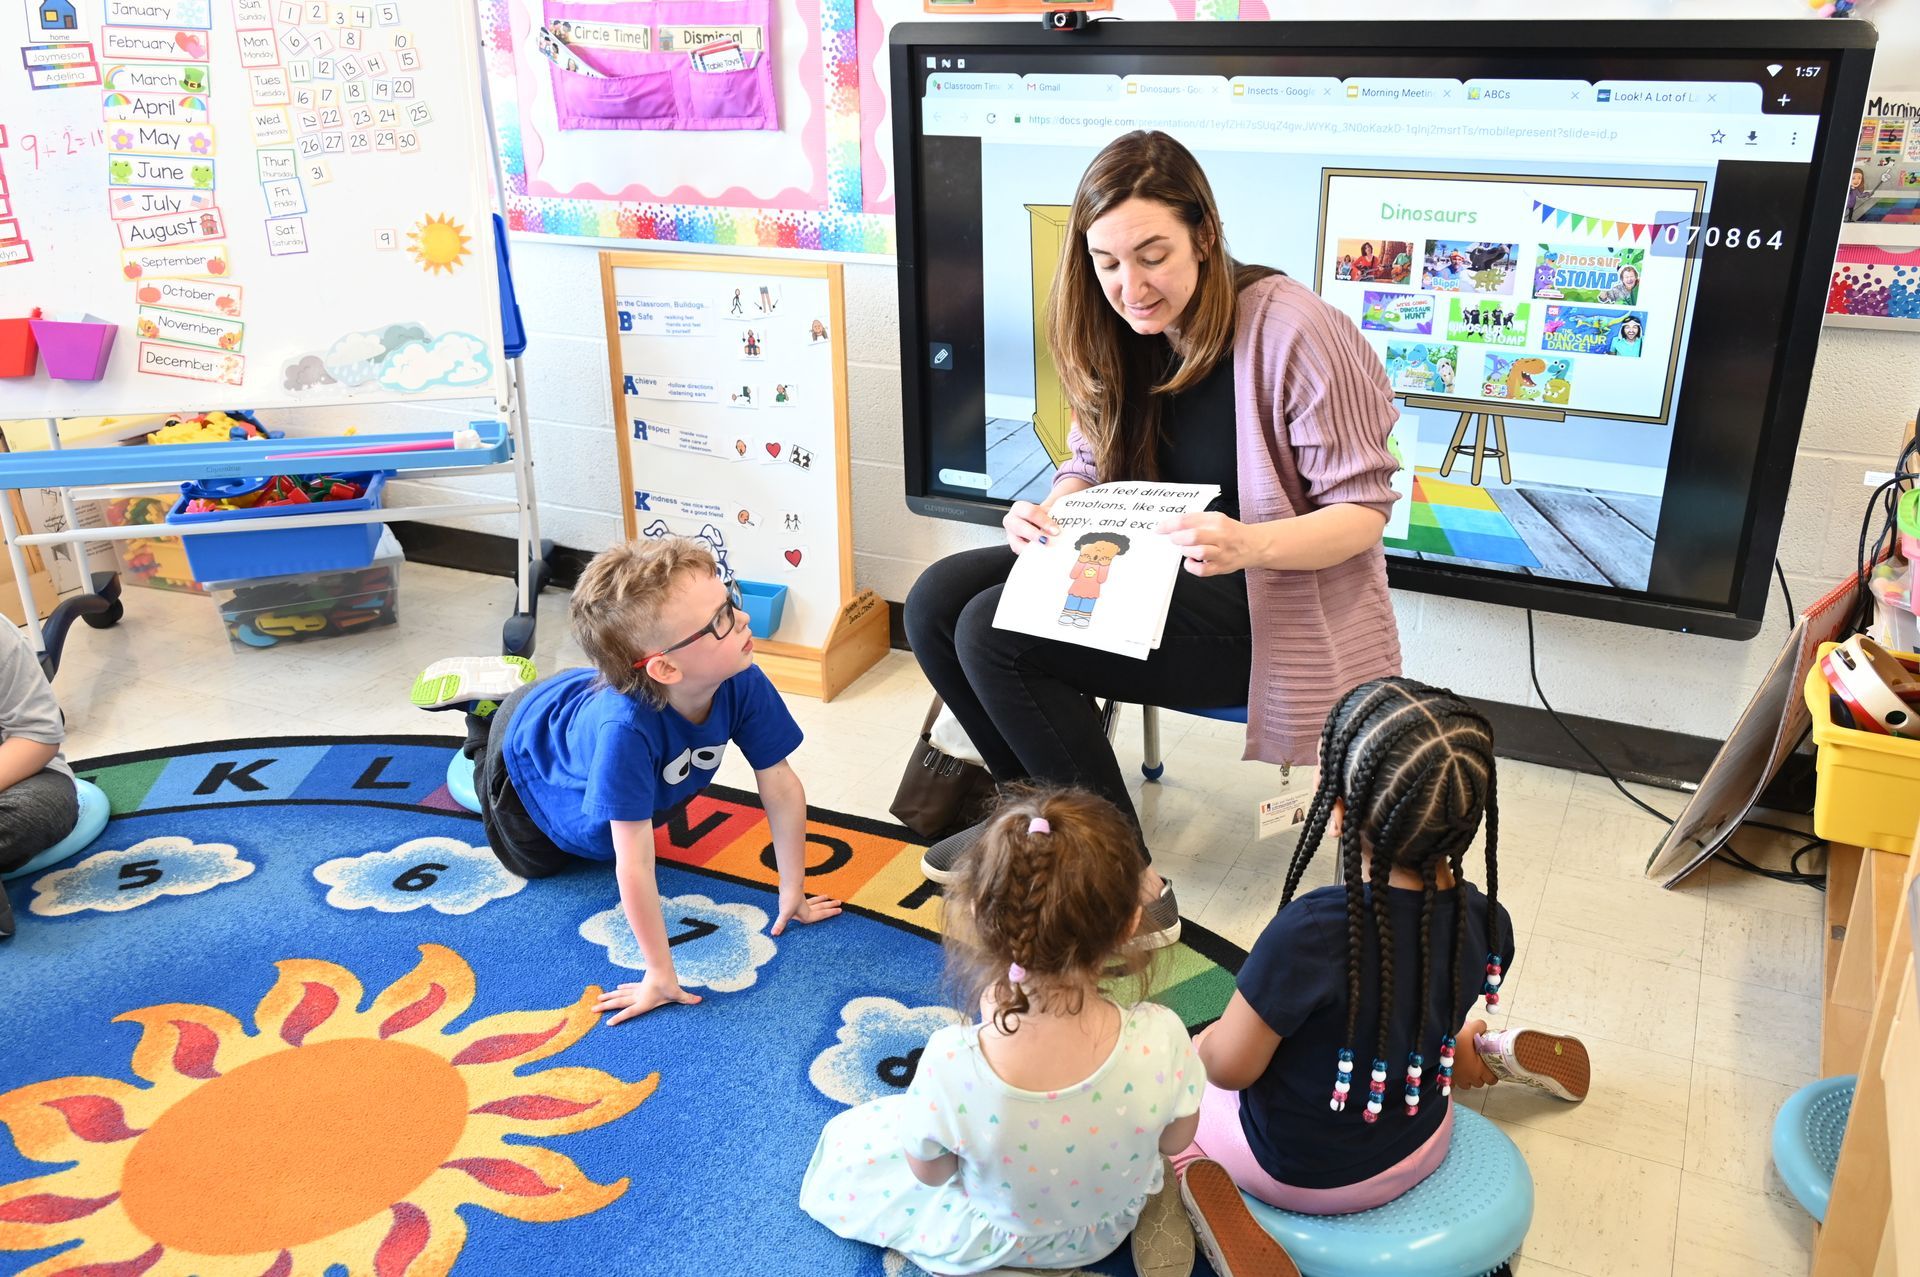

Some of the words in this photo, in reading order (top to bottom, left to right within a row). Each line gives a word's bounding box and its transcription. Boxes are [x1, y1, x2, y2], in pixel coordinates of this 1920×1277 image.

[112, 2, 170, 18] January
[288, 7, 292, 19] 1
[313, 6, 320, 18] 2
[337, 12, 344, 25] 3
[357, 11, 365, 24] 4
[384, 8, 393, 20] 5
[109, 35, 175, 51] February
[290, 36, 300, 47] 6
[314, 37, 322, 50] 7
[347, 33, 354, 45] 8
[395, 35, 406, 47] 10
[575, 26, 610, 41] Circle
[614, 29, 641, 44] Time
[684, 30, 742, 44] Dismial
[33, 51, 84, 63] Jaymeson
[294, 65, 305, 77] 11
[319, 61, 329, 74] 12
[343, 63, 356, 76] 13
[368, 58, 379, 71] 14
[402, 53, 414, 65] 15
[46, 71, 85, 81] Adelina
[131, 73, 177, 86] March
[1795, 66, 1821, 77] 1:57
[297, 91, 309, 104] 16
[322, 89, 332, 101] 17
[349, 85, 360, 97] 18
[376, 83, 388, 96] 19
[395, 80, 412, 93] 20
[944, 82, 982, 90] Classroom
[1039, 83, 1061, 92] Gmail
[1140, 85, 1181, 94] Dinosaurs
[1248, 87, 1279, 96] Insects
[1362, 88, 1399, 99] Morning
[1484, 90, 1510, 99] ABCs
[1614, 92, 1643, 102] Look!
[1646, 93, 1653, 102] A
[1656, 93, 1672, 102] Lot
[1675, 92, 1687, 102] of
[133, 98, 175, 118] April
[322, 110, 338, 124] 22
[354, 111, 370, 124] 23
[379, 109, 395, 123] 24
[411, 105, 428, 121] 25
[140, 128, 180, 149] May
[301, 138, 319, 153] 26
[325, 136, 341, 149] 27
[351, 134, 367, 147] 28
[377, 132, 394, 146] 29
[399, 133, 416, 147] 30
[138, 161, 183, 180] June
[312, 166, 323, 179] 31
[142, 195, 180, 212] July
[1381, 203, 1477, 223] Dinosaurs
[131, 218, 197, 242] August
[1665, 225, 1783, 250] 070864
[381, 233, 390, 246] 9
[141, 256, 206, 268] September
[1558, 254, 1620, 267] Dinosaur
[1433, 277, 1458, 288] Blippi
[1555, 270, 1618, 289] STOMP
[163, 284, 215, 300] October
[158, 315, 223, 336] November
[1545, 332, 1607, 345] DINOSAUR
[1548, 341, 1590, 352] DANCE!
[1112, 487, 1139, 495] feel
[1141, 487, 1200, 498] different
[1065, 500, 1127, 511] emotions,
[1132, 503, 1155, 512] like
[1159, 504, 1187, 514] sad,
[1099, 517, 1127, 528] and
[1130, 521, 1157, 530] exc
[193, 759, 278, 795] K
[351, 757, 411, 790] L
[118, 859, 166, 891] 5
[392, 863, 449, 891] 6
